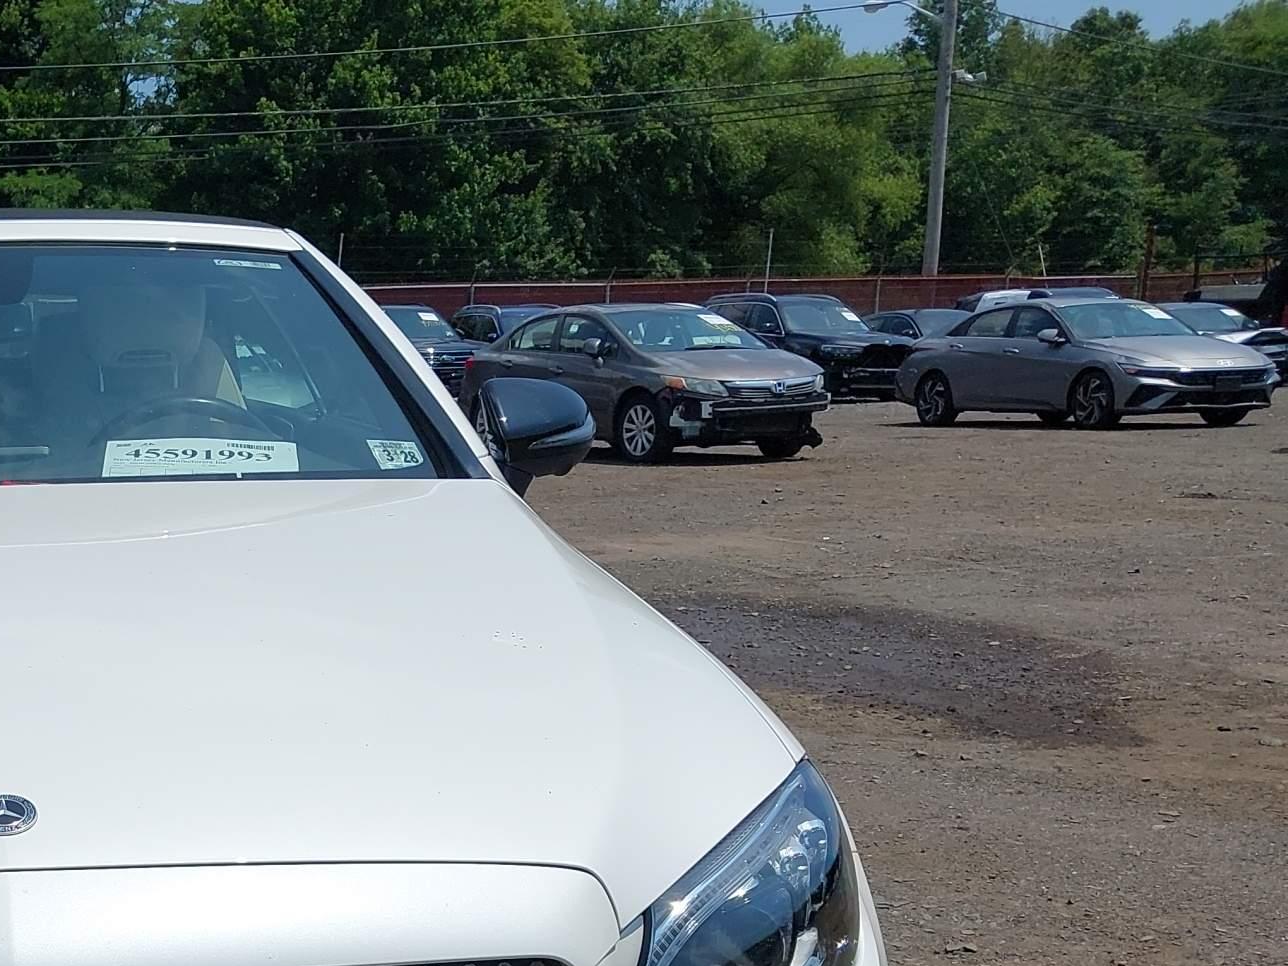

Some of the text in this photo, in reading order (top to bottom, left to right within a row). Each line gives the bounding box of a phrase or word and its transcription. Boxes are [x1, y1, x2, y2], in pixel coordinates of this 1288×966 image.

[125, 448, 272, 462] 45591993
[382, 449, 420, 464] 3 28
